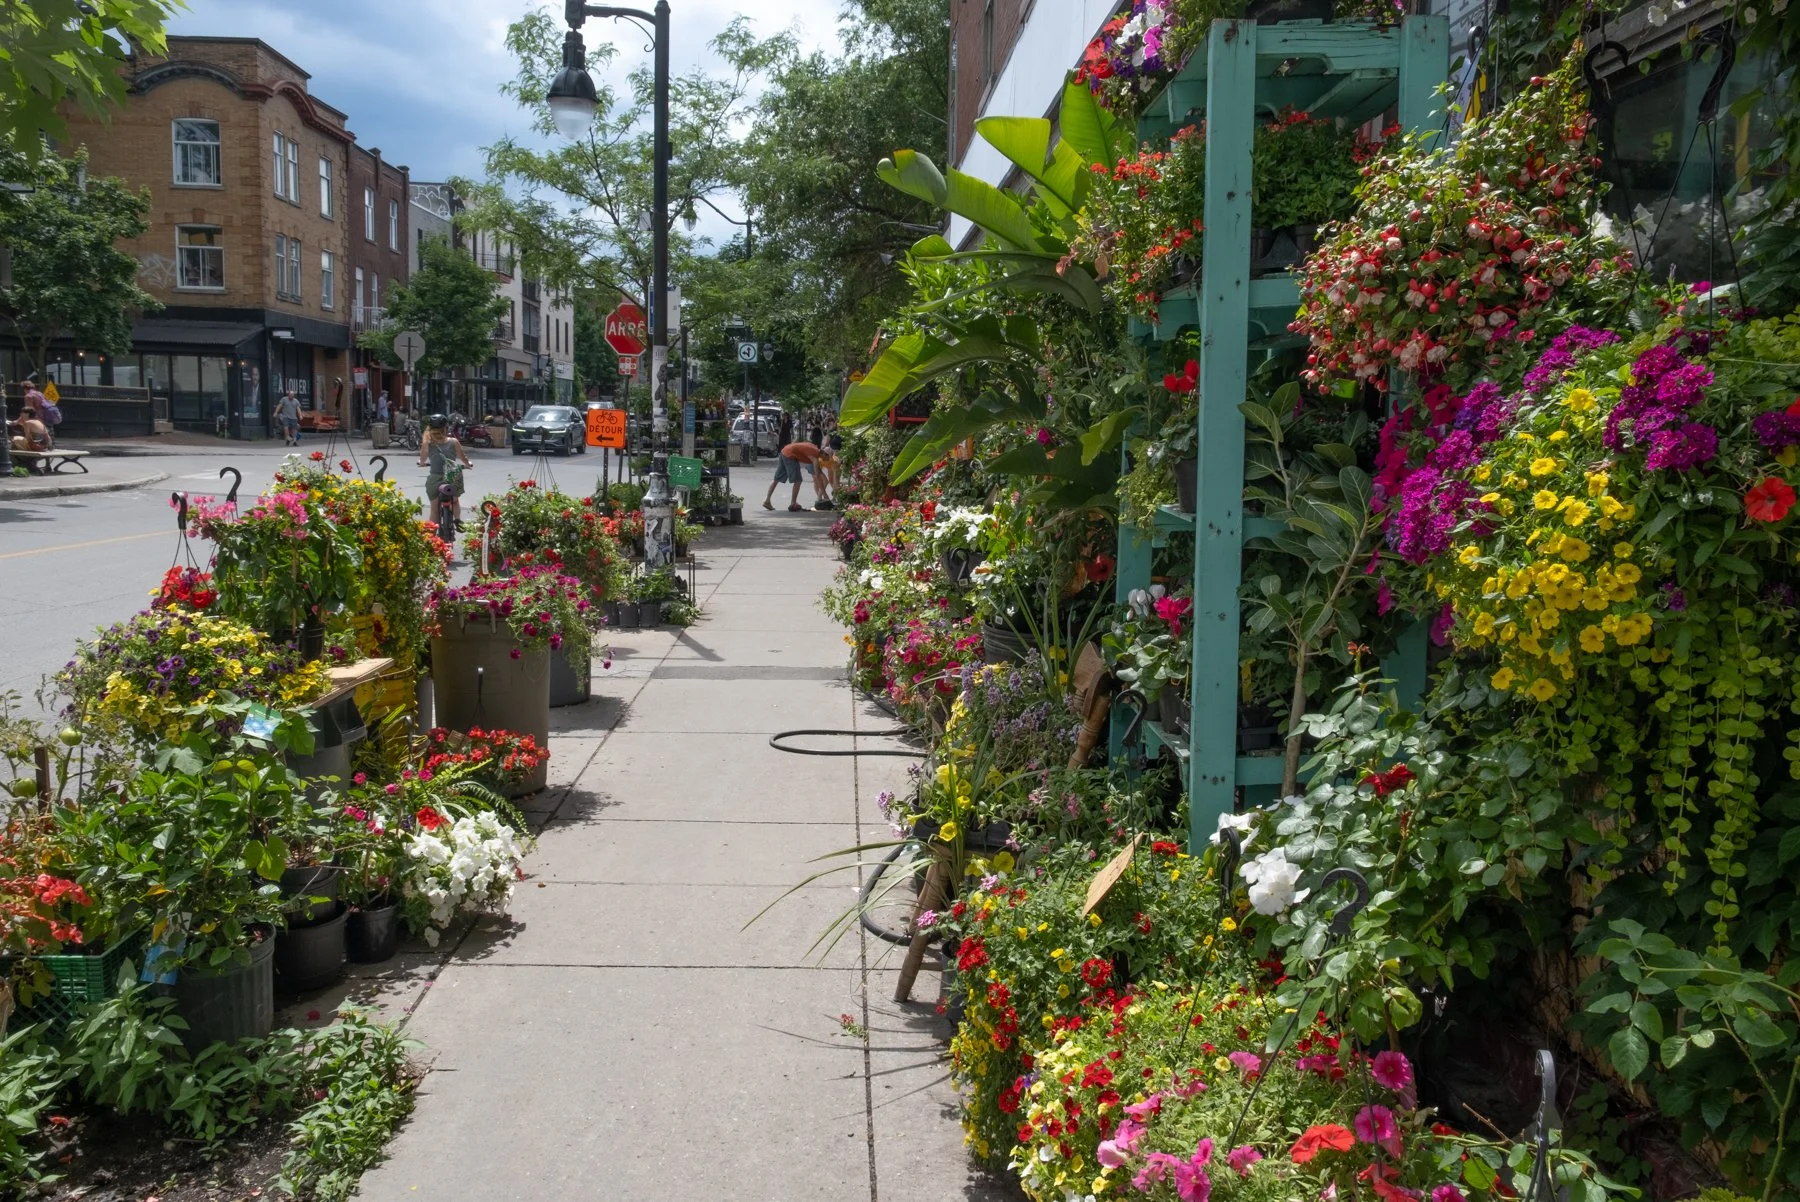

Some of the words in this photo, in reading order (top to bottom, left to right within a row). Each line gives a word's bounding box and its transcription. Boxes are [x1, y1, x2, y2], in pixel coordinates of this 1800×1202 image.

[608, 320, 646, 337] ARRÊ
[278, 373, 284, 393] À
[285, 377, 307, 394] LOUER
[589, 424, 623, 434] DÉTOUR
